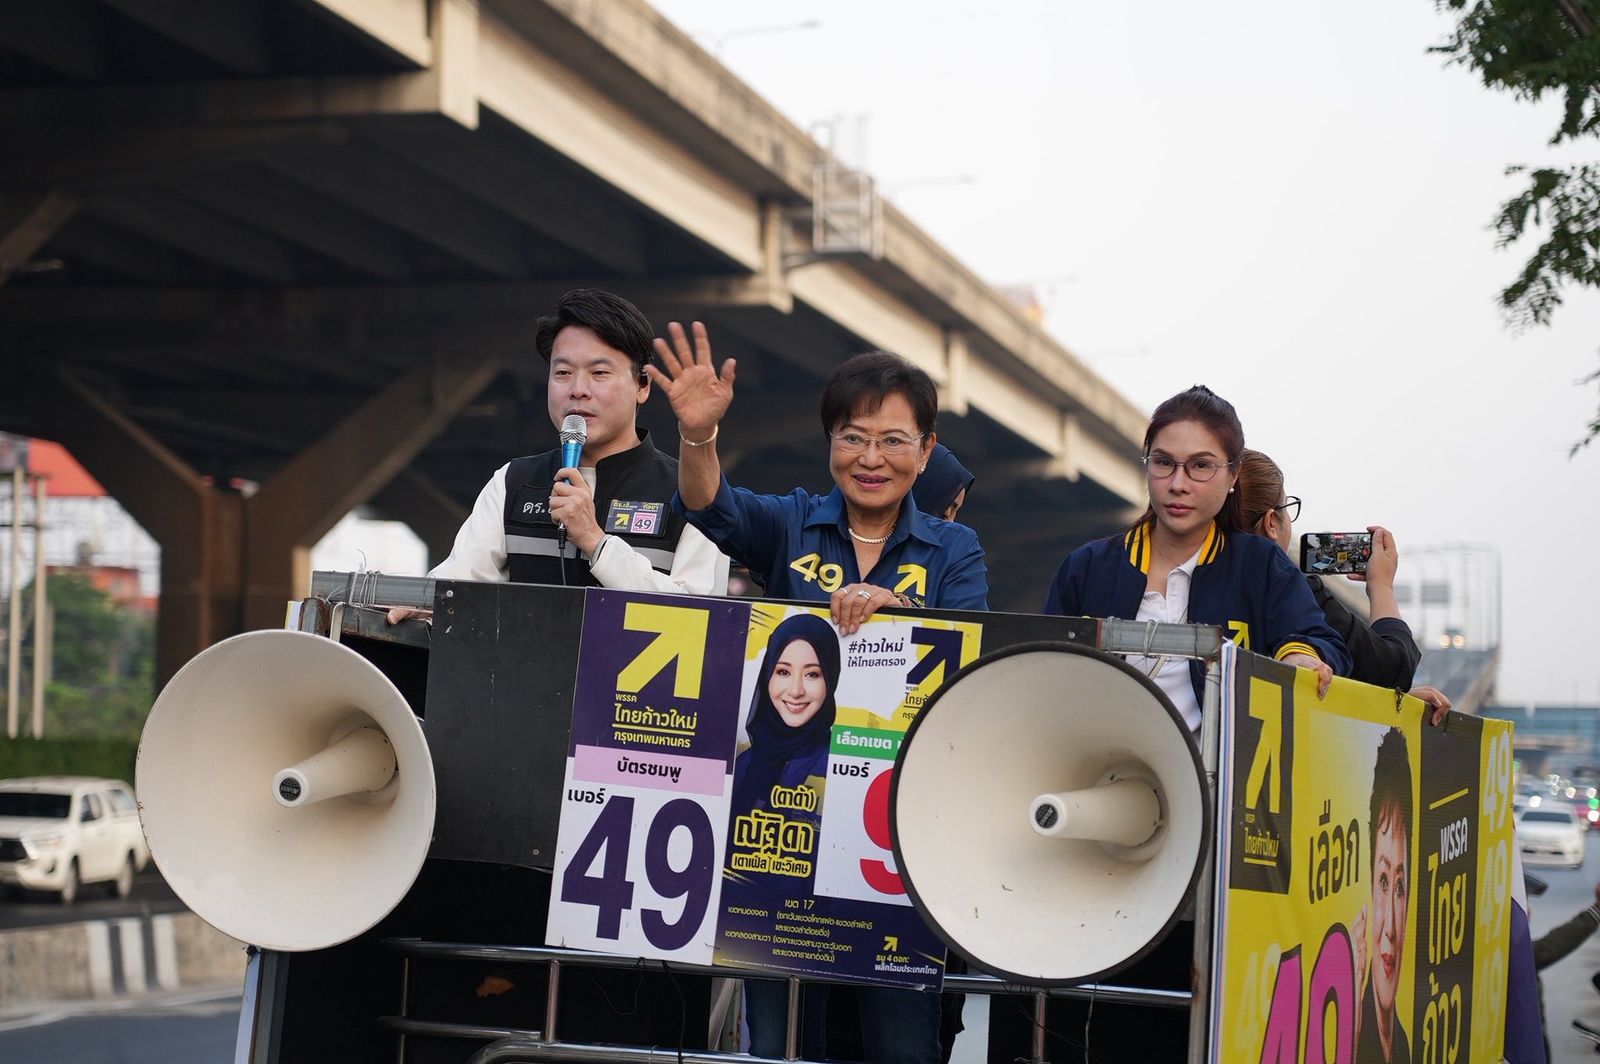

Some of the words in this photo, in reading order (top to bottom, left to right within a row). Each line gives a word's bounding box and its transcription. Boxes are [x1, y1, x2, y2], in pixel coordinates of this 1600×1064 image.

[635, 518, 652, 530] 49
[789, 552, 844, 593] 49
[848, 637, 905, 654] #ก้าวใหม่
[847, 656, 906, 668] ให้ไทยสตรอง
[615, 693, 637, 702] พรรค
[614, 703, 698, 730] ไทยก้าวใหม่
[613, 731, 691, 748] กรุงเทพมหานคร
[836, 731, 893, 750] เลือกเขต
[617, 756, 682, 784] บัตรชมพู
[832, 761, 871, 779] เบอร์
[1483, 730, 1510, 833] 49
[567, 786, 606, 805] เบอร์
[1308, 799, 1360, 905] เลือก
[1440, 817, 1468, 864] พรรค
[560, 794, 715, 951] 49
[1479, 839, 1508, 944] 49
[785, 899, 800, 909] เขต
[803, 899, 815, 910] 17
[1427, 851, 1467, 966] ไทย
[886, 954, 893, 962] 4
[1422, 971, 1463, 1064] ก้าว
